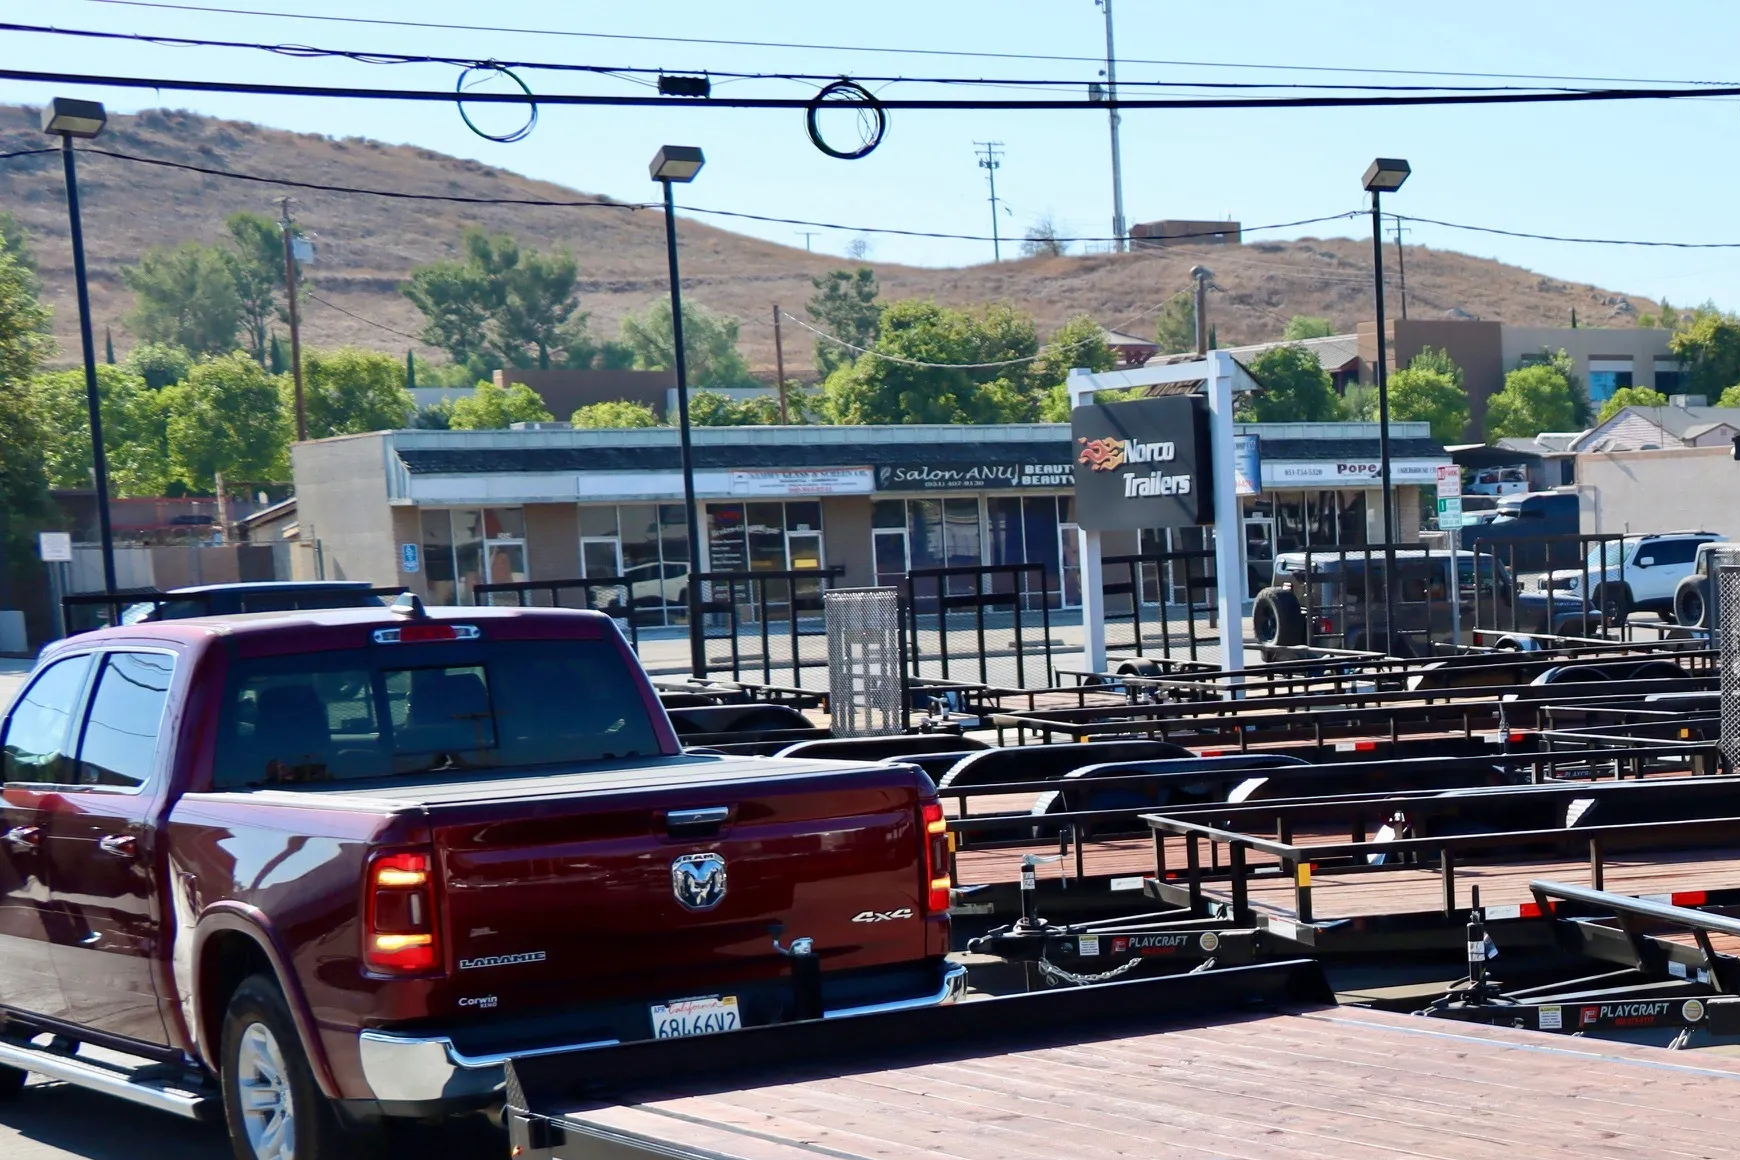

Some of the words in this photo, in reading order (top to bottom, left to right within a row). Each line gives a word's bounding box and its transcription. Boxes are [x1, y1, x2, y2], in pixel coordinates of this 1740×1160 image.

[1124, 439, 1175, 463] Norco
[893, 466, 964, 482] Salon
[1123, 471, 1190, 498] Trailers
[683, 853, 714, 861] RAM
[851, 908, 914, 923] 4x4
[1129, 935, 1188, 948] PLAYCRAFT
[459, 951, 546, 969] LARAMIE
[458, 994, 498, 1006] Corwin
[668, 1002, 719, 1015] California
[1600, 1002, 1670, 1018] PLAYCRAFT
